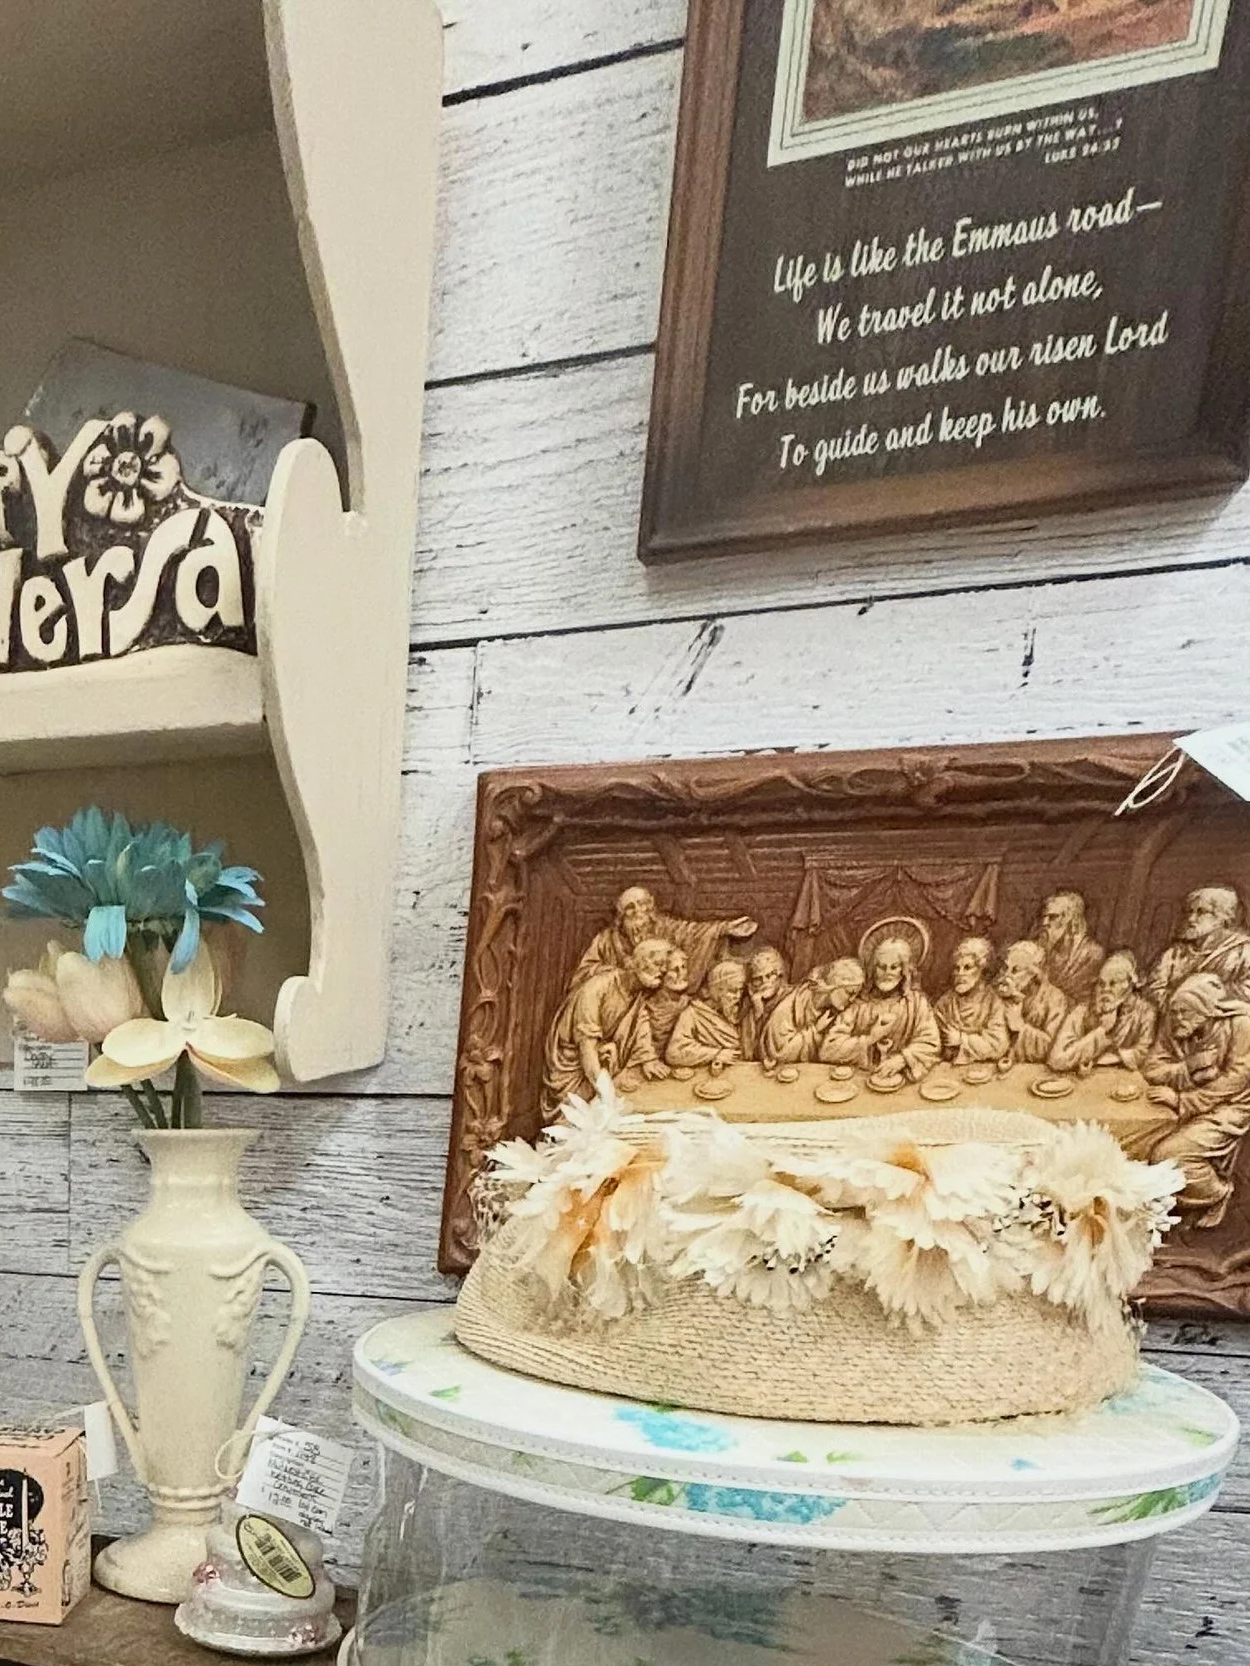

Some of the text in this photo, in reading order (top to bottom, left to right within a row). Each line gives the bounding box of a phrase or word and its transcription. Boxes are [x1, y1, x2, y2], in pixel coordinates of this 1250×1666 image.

[844, 172, 882, 188] WHILE
[905, 155, 954, 176] TALKED
[957, 147, 992, 165] WITH
[872, 150, 899, 165] NOT
[903, 145, 930, 160] OUR
[934, 133, 984, 153] HEARTS
[987, 124, 1023, 141] BURN
[1026, 111, 1074, 132] WITHIN
[773, 254, 818, 302] Life
[822, 254, 845, 283] is
[850, 236, 897, 277] like
[902, 228, 946, 266] the
[951, 216, 1059, 258] Emmaus
[817, 265, 1103, 344] We travel it not alone,
[735, 311, 1170, 419] For beside us walks our risen Lord
[779, 392, 1107, 477] To guide and keep his own.
